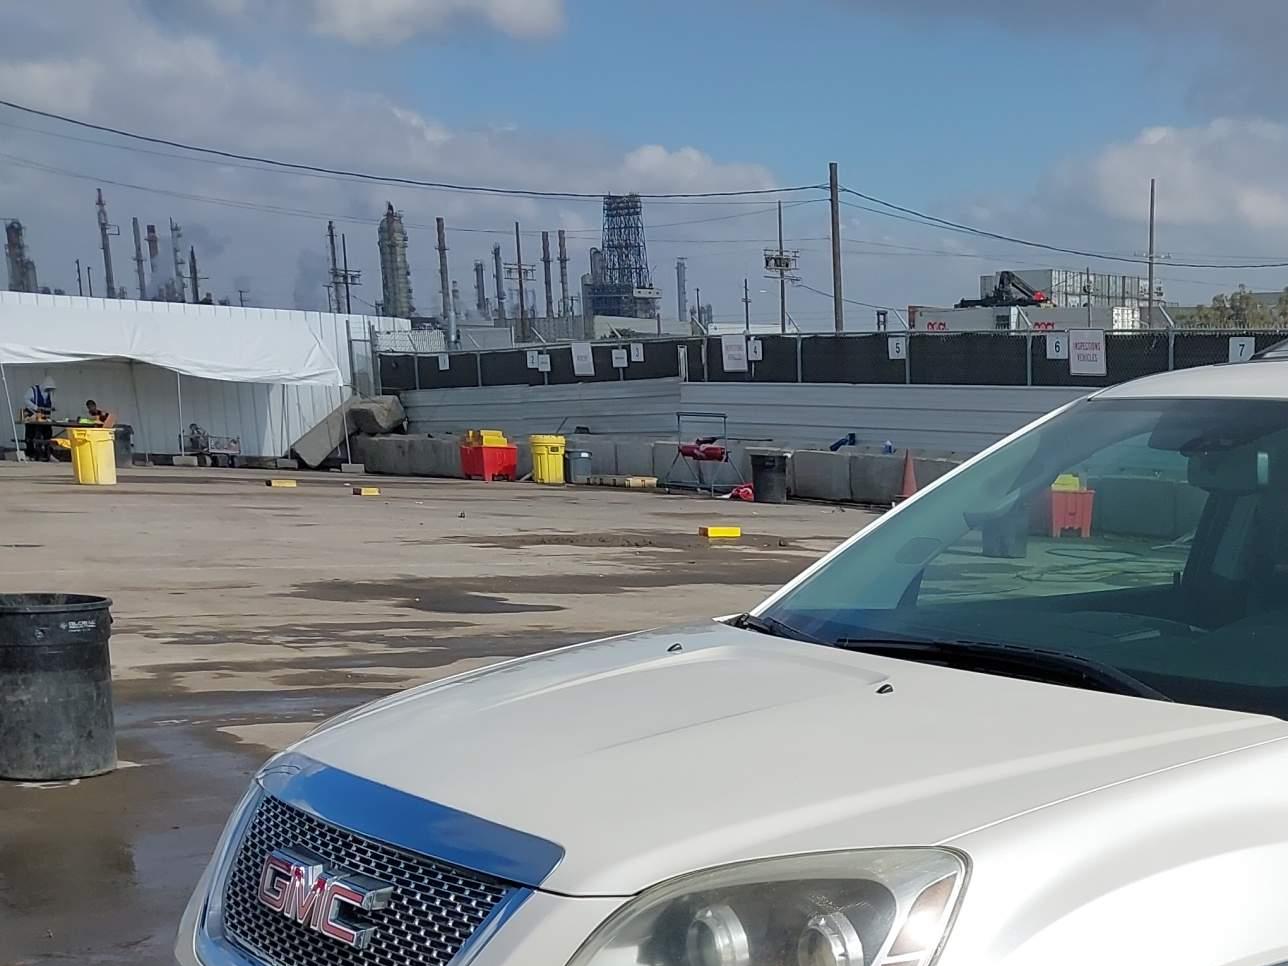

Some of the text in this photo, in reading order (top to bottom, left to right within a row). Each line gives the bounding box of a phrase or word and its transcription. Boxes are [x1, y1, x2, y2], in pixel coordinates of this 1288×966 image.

[895, 342, 901, 354] 5
[1054, 341, 1061, 353] 6
[1238, 344, 1245, 356] 7
[257, 851, 385, 948] GMC
